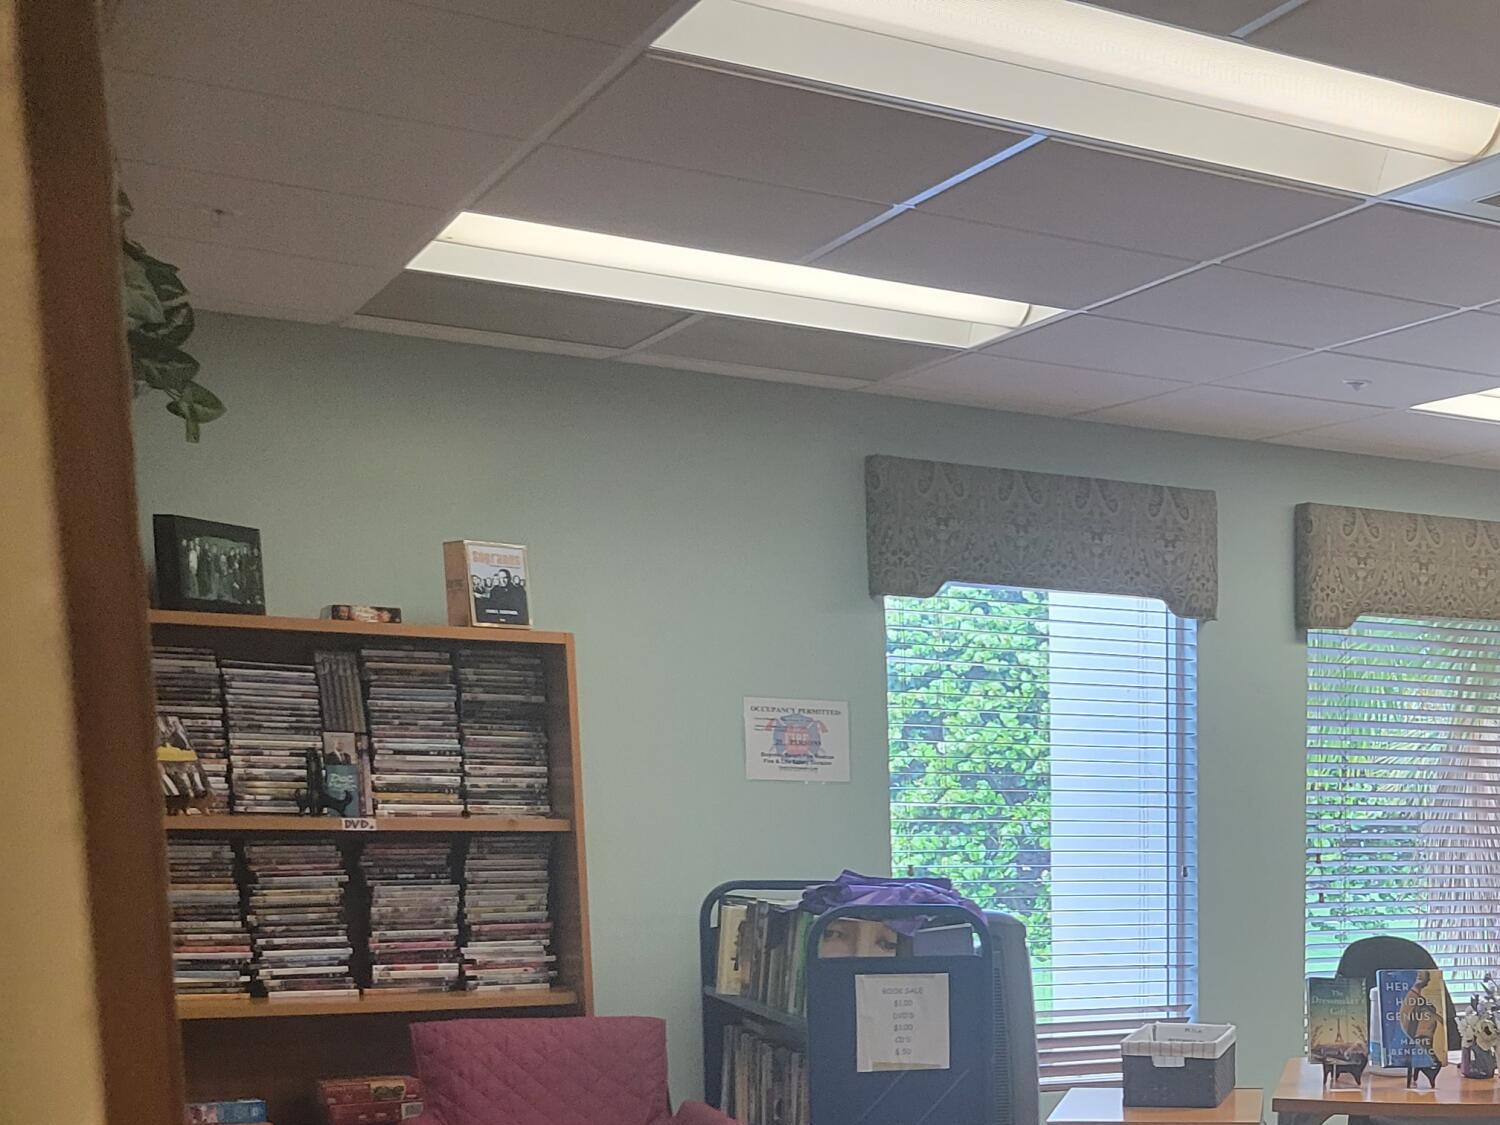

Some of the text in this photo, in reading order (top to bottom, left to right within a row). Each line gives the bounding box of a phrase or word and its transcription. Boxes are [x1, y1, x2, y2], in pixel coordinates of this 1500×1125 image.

[750, 705, 841, 715] OCCUPANCY PERMITTED
[1386, 982, 1409, 991] HER
[1396, 998, 1433, 1006] HIDDE
[1386, 1012, 1431, 1021] GENIUS
[1391, 1048, 1435, 1056] BENEDIC
